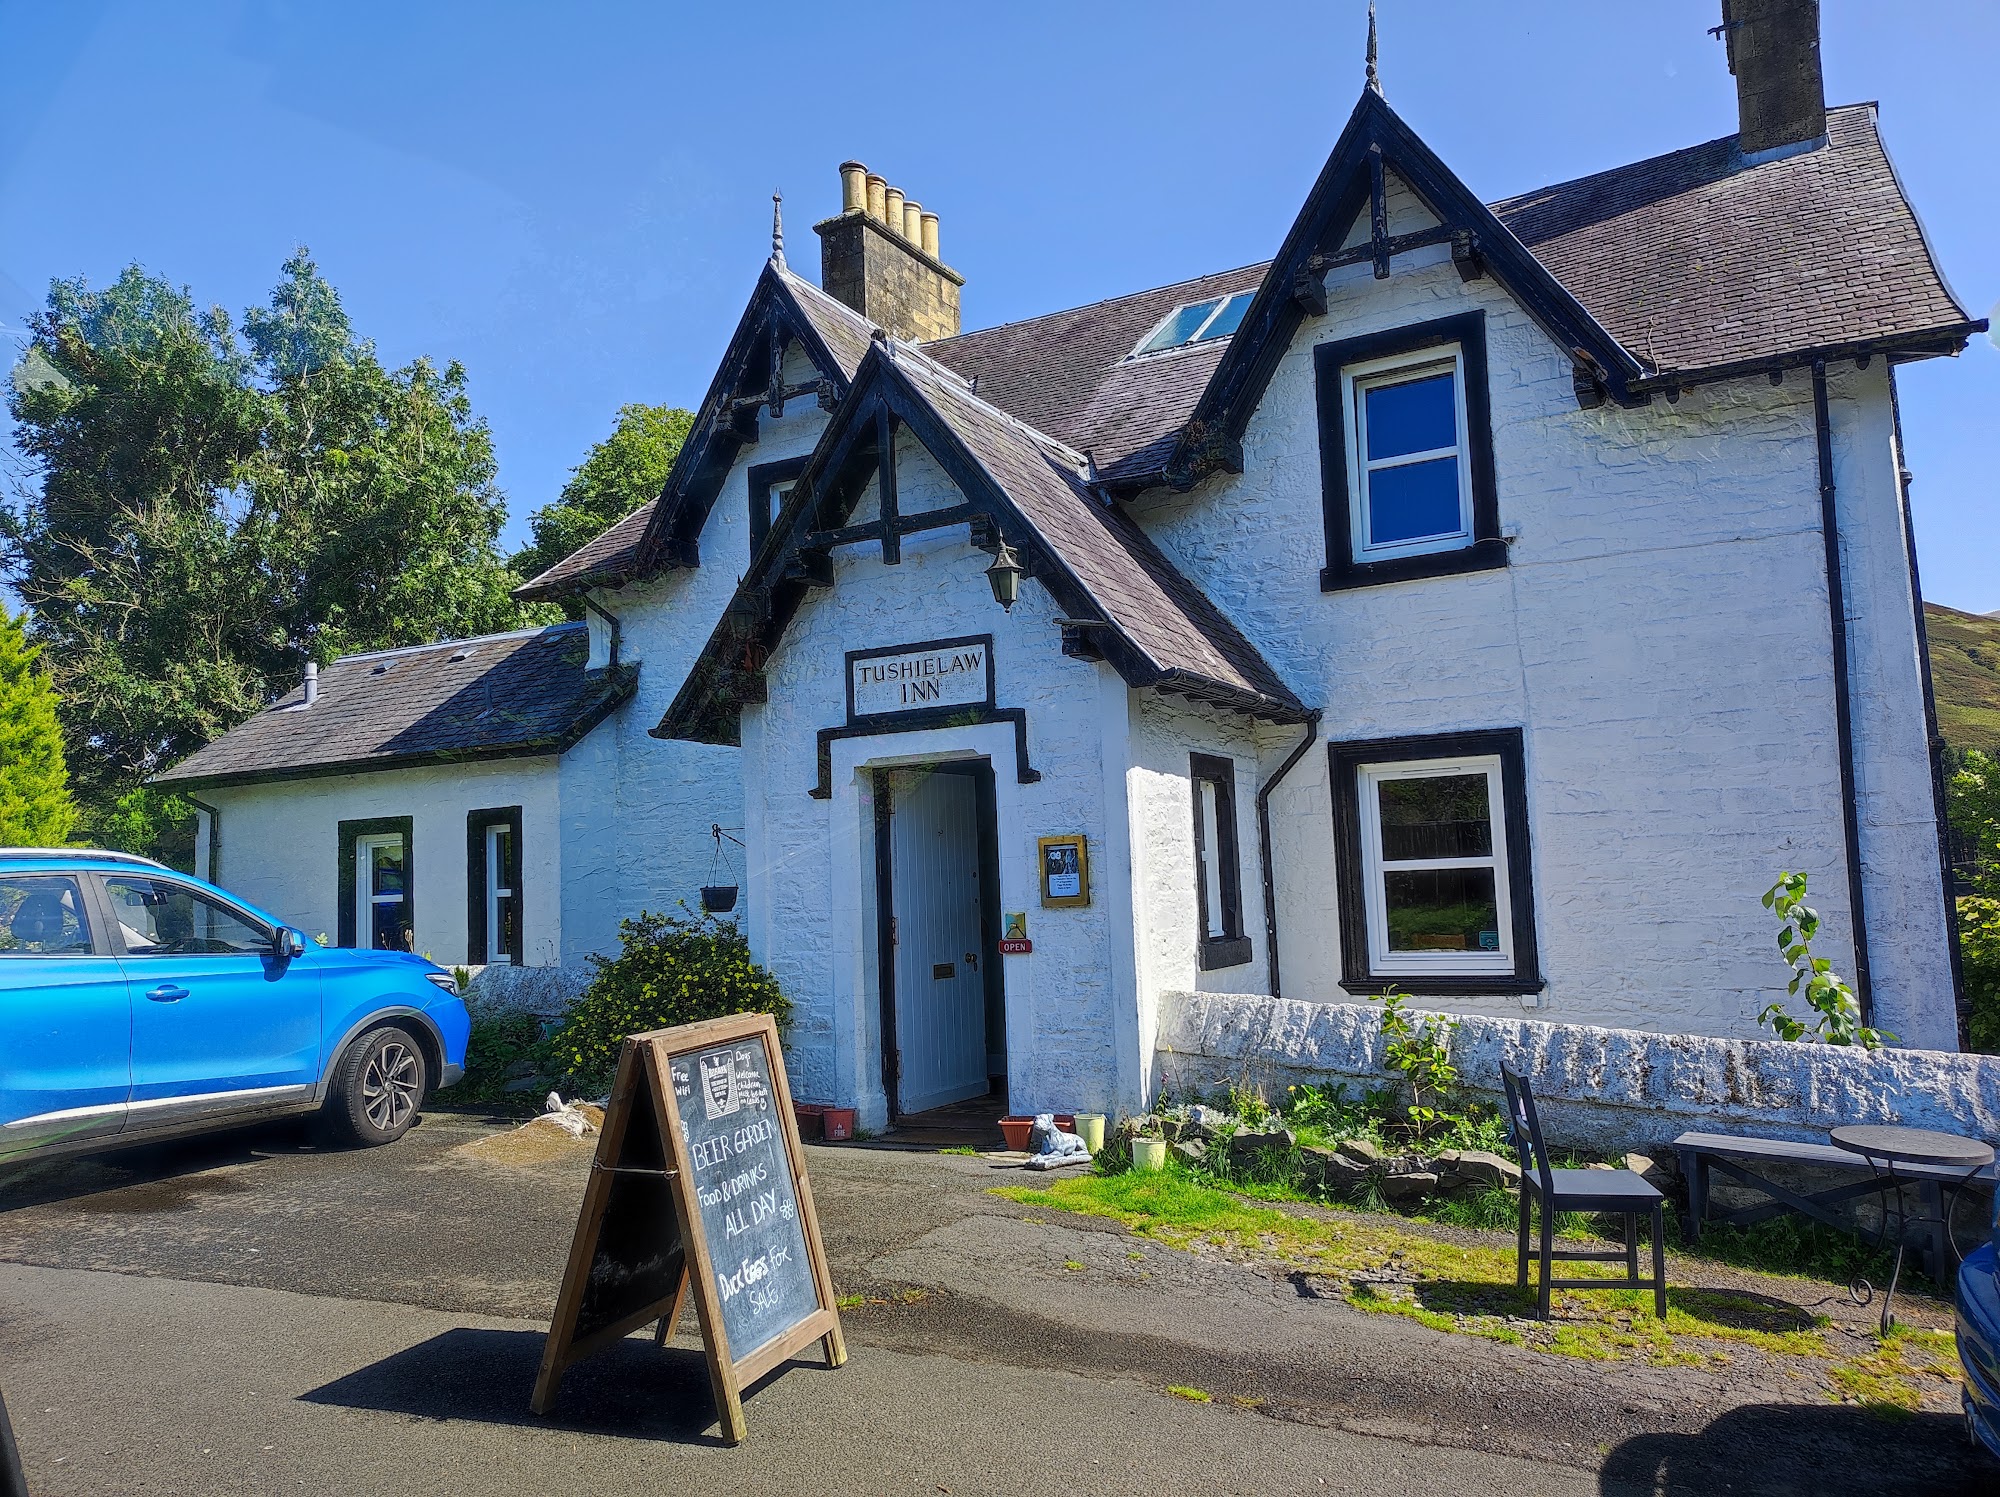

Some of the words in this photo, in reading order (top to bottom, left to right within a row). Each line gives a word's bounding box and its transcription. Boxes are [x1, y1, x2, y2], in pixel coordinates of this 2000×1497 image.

[859, 652, 982, 685] TUSHIELAW
[901, 679, 940, 704] INN
[1003, 943, 1026, 952] OPEN
[736, 1050, 752, 1068] Dogs
[671, 1066, 690, 1082] Free
[692, 1135, 734, 1172] BEER
[734, 1115, 778, 1154] GARDEN
[834, 1129, 846, 1137] FIRE
[726, 1208, 750, 1240] ALL
[751, 1187, 776, 1225] DAY
[750, 1280, 779, 1315] SALE
